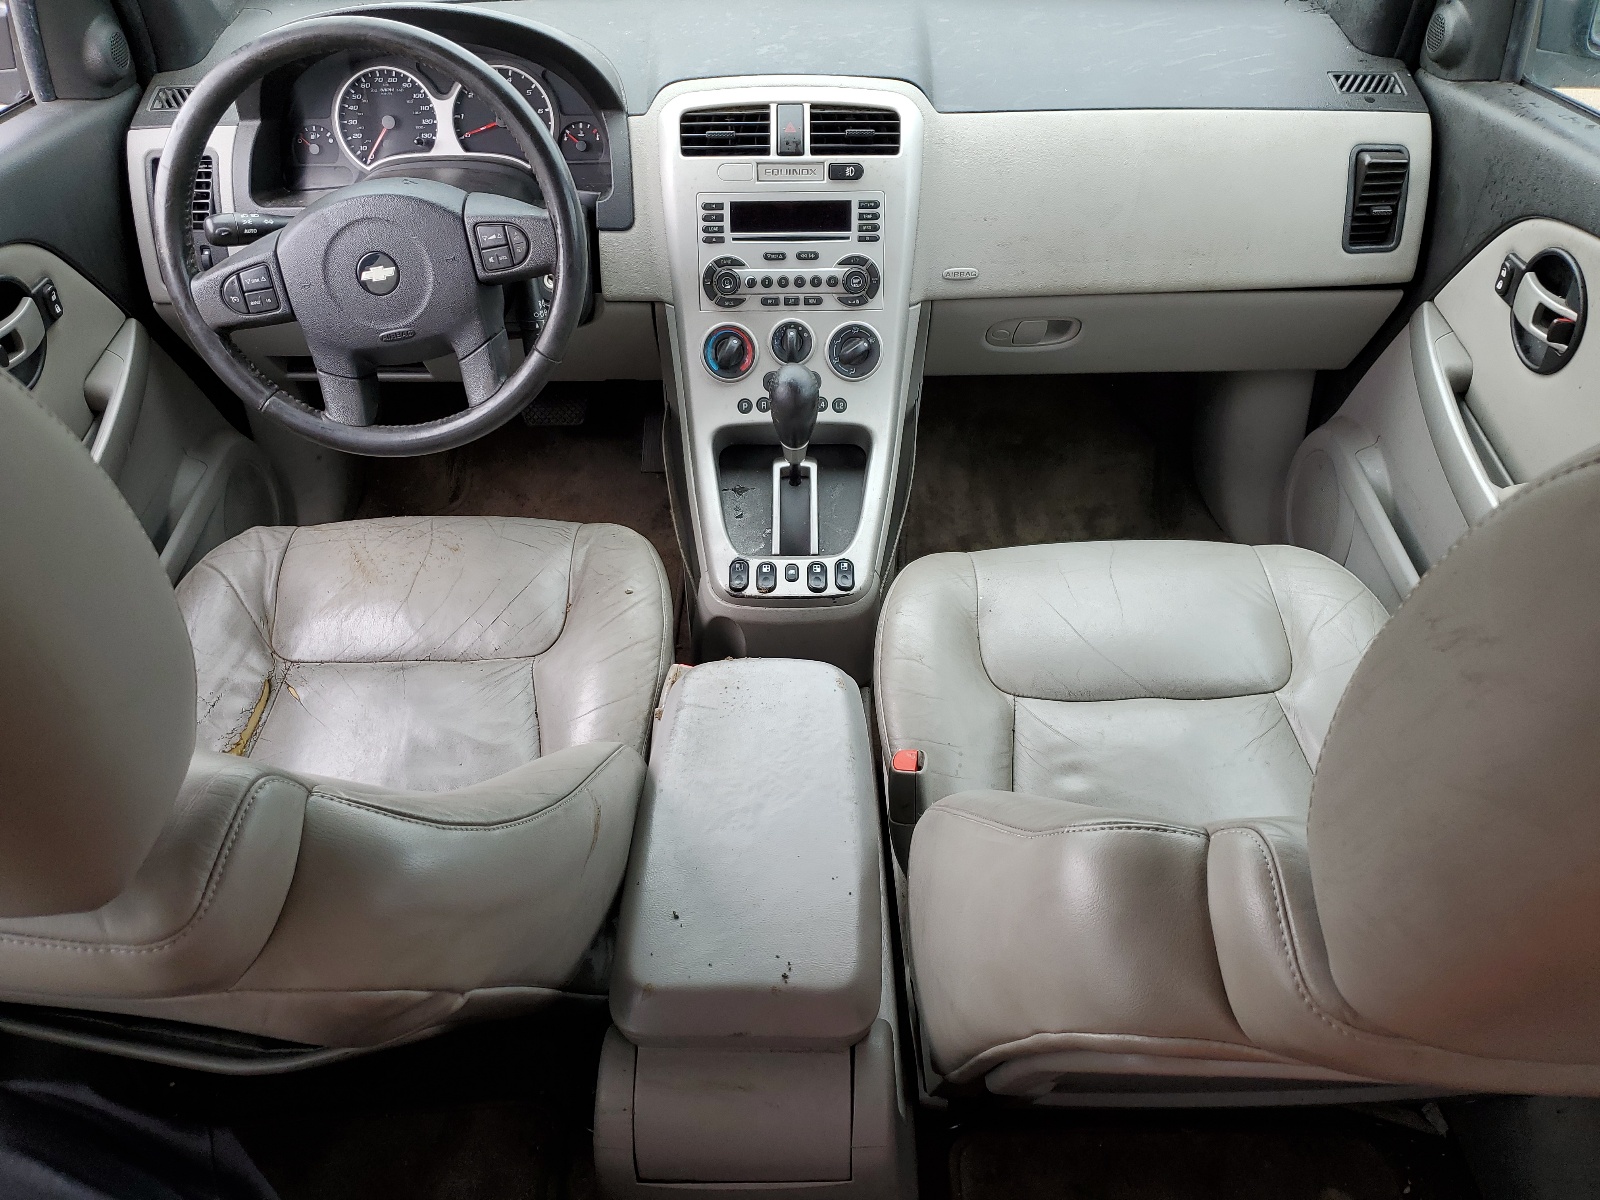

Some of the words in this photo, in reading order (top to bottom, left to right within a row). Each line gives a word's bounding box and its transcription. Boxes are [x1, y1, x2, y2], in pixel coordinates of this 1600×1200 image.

[764, 168, 818, 177] EQUINOX
[944, 270, 978, 278] AIRBAG
[742, 402, 748, 410] P
